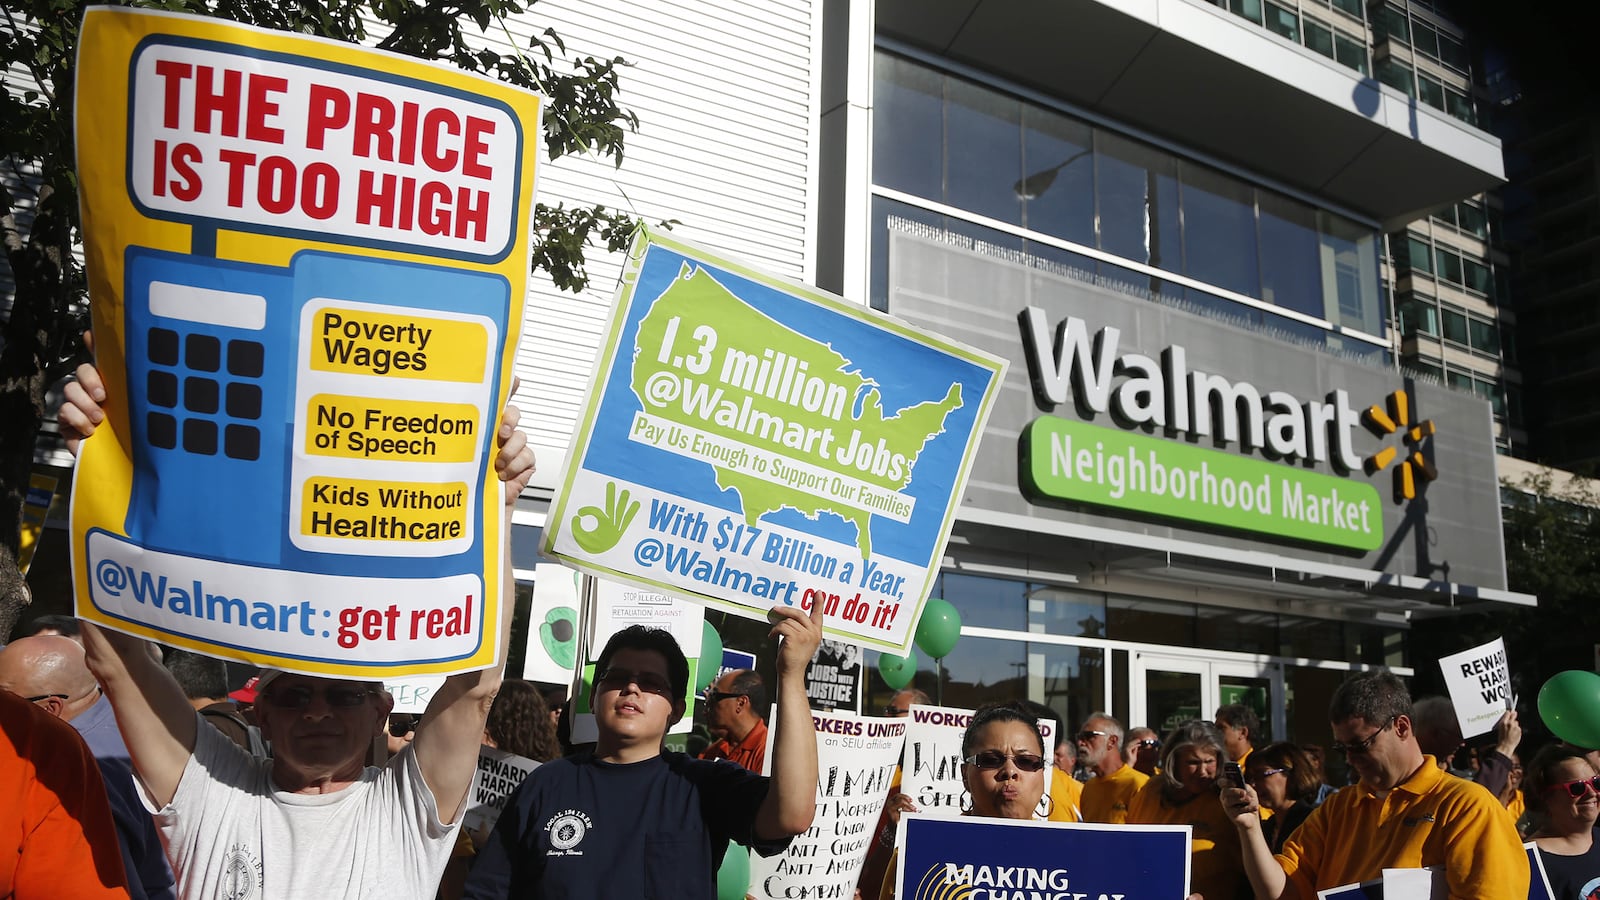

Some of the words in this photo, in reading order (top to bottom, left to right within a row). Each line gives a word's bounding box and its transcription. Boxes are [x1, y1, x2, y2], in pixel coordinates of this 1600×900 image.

[156, 60, 288, 144] THE
[306, 83, 496, 181] PRICE
[152, 139, 202, 202] IS
[219, 149, 340, 220] TOO
[356, 170, 489, 242] HIGH
[323, 313, 432, 350] Poverty
[323, 338, 427, 374] Wages
[657, 316, 718, 375] 1.3
[720, 347, 847, 421] million
[1019, 305, 1361, 473] Walmart
[317, 405, 355, 428] No
[365, 409, 473, 435] Freedom
[645, 371, 836, 459] @Walmart
[836, 430, 908, 481] Jobs
[315, 431, 340, 449] of
[348, 431, 436, 456] Speech
[634, 415, 662, 445] Pay
[667, 426, 689, 449] Us
[691, 434, 749, 469] Enough
[753, 456, 768, 474] to
[770, 458, 828, 495] Support
[830, 477, 856, 501] Our
[858, 485, 911, 518] Families
[1050, 431, 1271, 515] Neighborhood
[1282, 479, 1371, 534] Market
[313, 483, 369, 506] Kids
[378, 488, 462, 509] Without
[311, 511, 461, 540] Healthcare
[648, 498, 708, 544] With
[712, 516, 762, 557] $17
[762, 530, 835, 580] Billion
[839, 563, 850, 585] a
[857, 558, 906, 601] Year,
[633, 538, 799, 606] @Walmart
[801, 588, 835, 616] cn
[842, 596, 869, 627] do
[871, 603, 900, 631] it!
[337, 604, 400, 648] get
[409, 595, 472, 641] real
[807, 663, 838, 683] JOBS
[806, 681, 852, 702] JUSTICE
[1481, 682, 1511, 704] WOR
[812, 716, 863, 736] RKERS
[867, 723, 906, 737] UNITED
[825, 738, 838, 746] an
[841, 737, 865, 749] SEIU
[866, 740, 892, 749] affiliate
[476, 787, 506, 810] WOR
[481, 772, 515, 796] HARD
[944, 862, 1069, 891] MAKING
